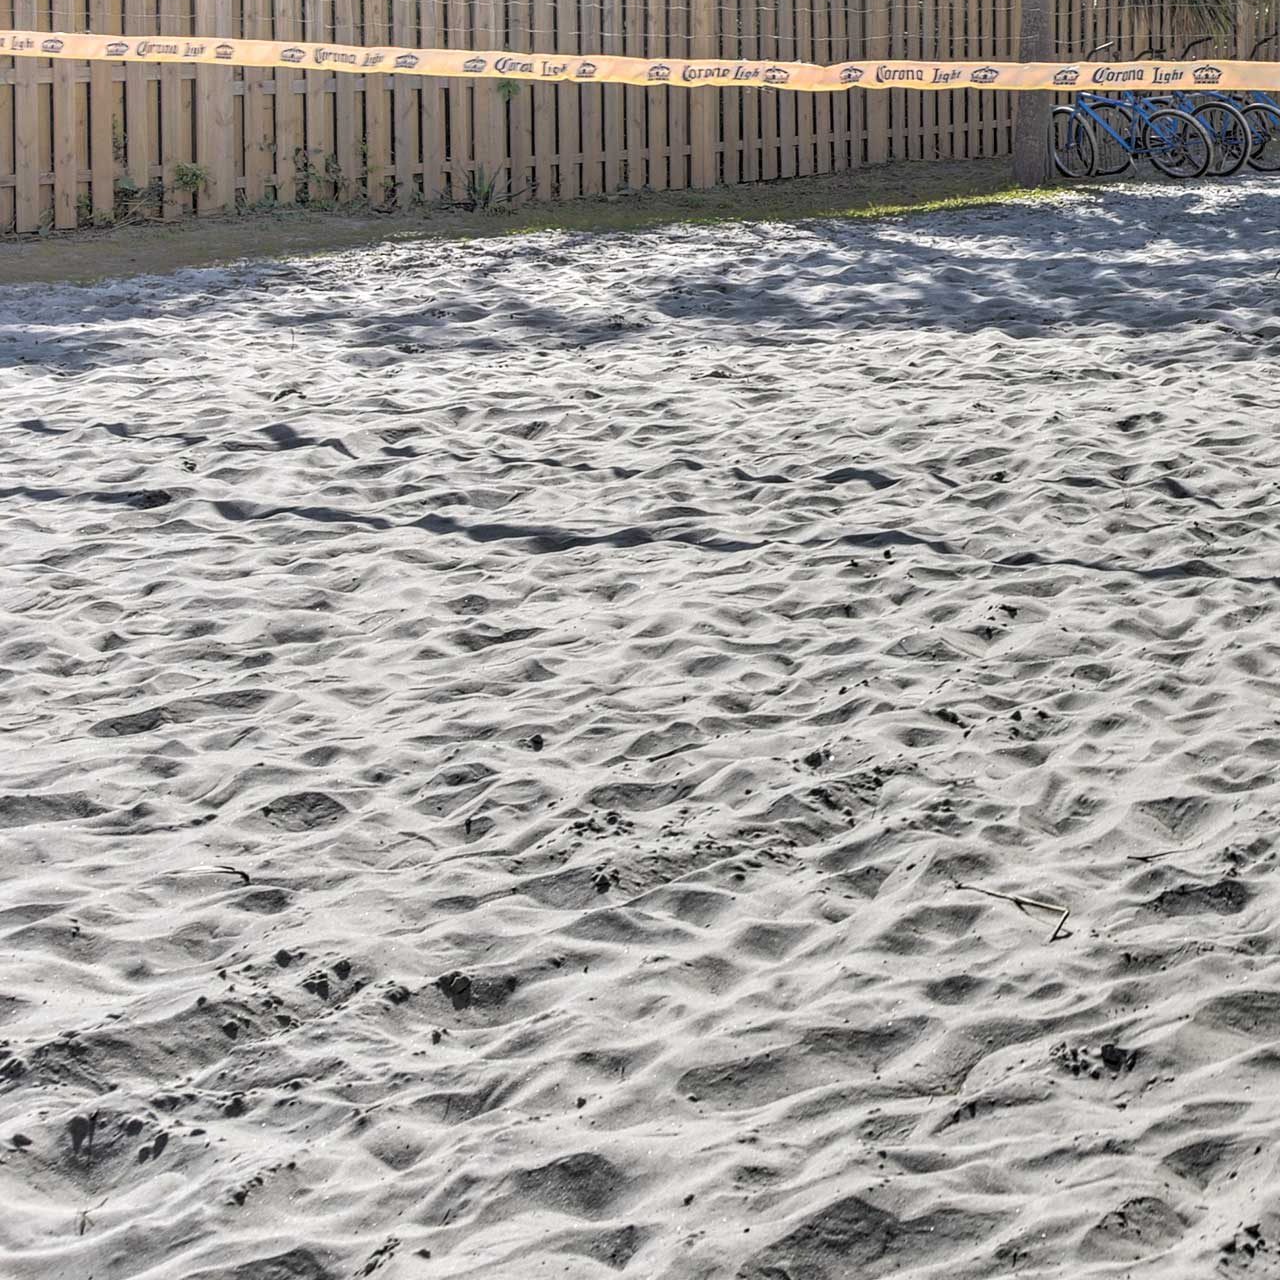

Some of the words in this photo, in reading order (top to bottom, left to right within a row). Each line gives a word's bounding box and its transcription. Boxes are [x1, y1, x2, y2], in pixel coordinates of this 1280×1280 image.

[732, 65, 760, 81] Ligh
[875, 65, 923, 83] Corona
[932, 66, 962, 84] Light
[1092, 66, 1144, 87] Corona
[1151, 66, 1184, 85] Light
